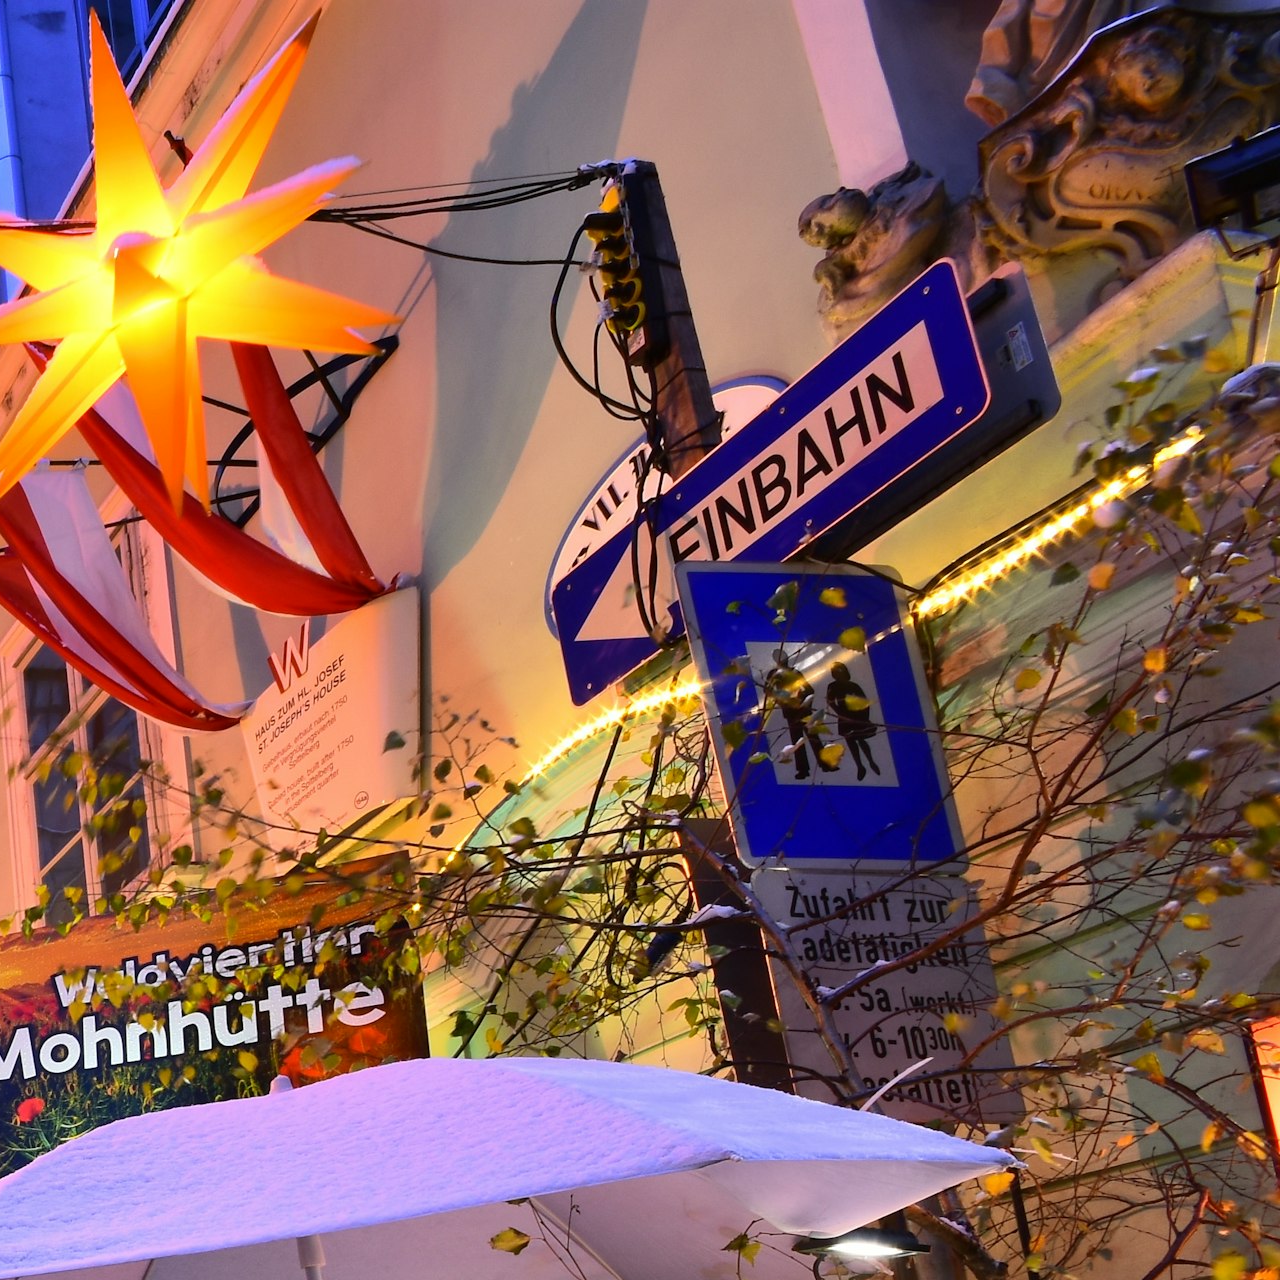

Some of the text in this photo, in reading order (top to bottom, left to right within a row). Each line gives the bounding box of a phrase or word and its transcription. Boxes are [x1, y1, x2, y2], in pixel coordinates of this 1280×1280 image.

[669, 351, 916, 564] EINBAHN
[580, 482, 629, 532] VII.
[255, 654, 344, 741] HAUS ZUM HL. JOSEF
[258, 669, 346, 755] ST. JOSEPH'S HOUSE
[331, 695, 348, 712] 1750
[337, 734, 354, 752] 1750
